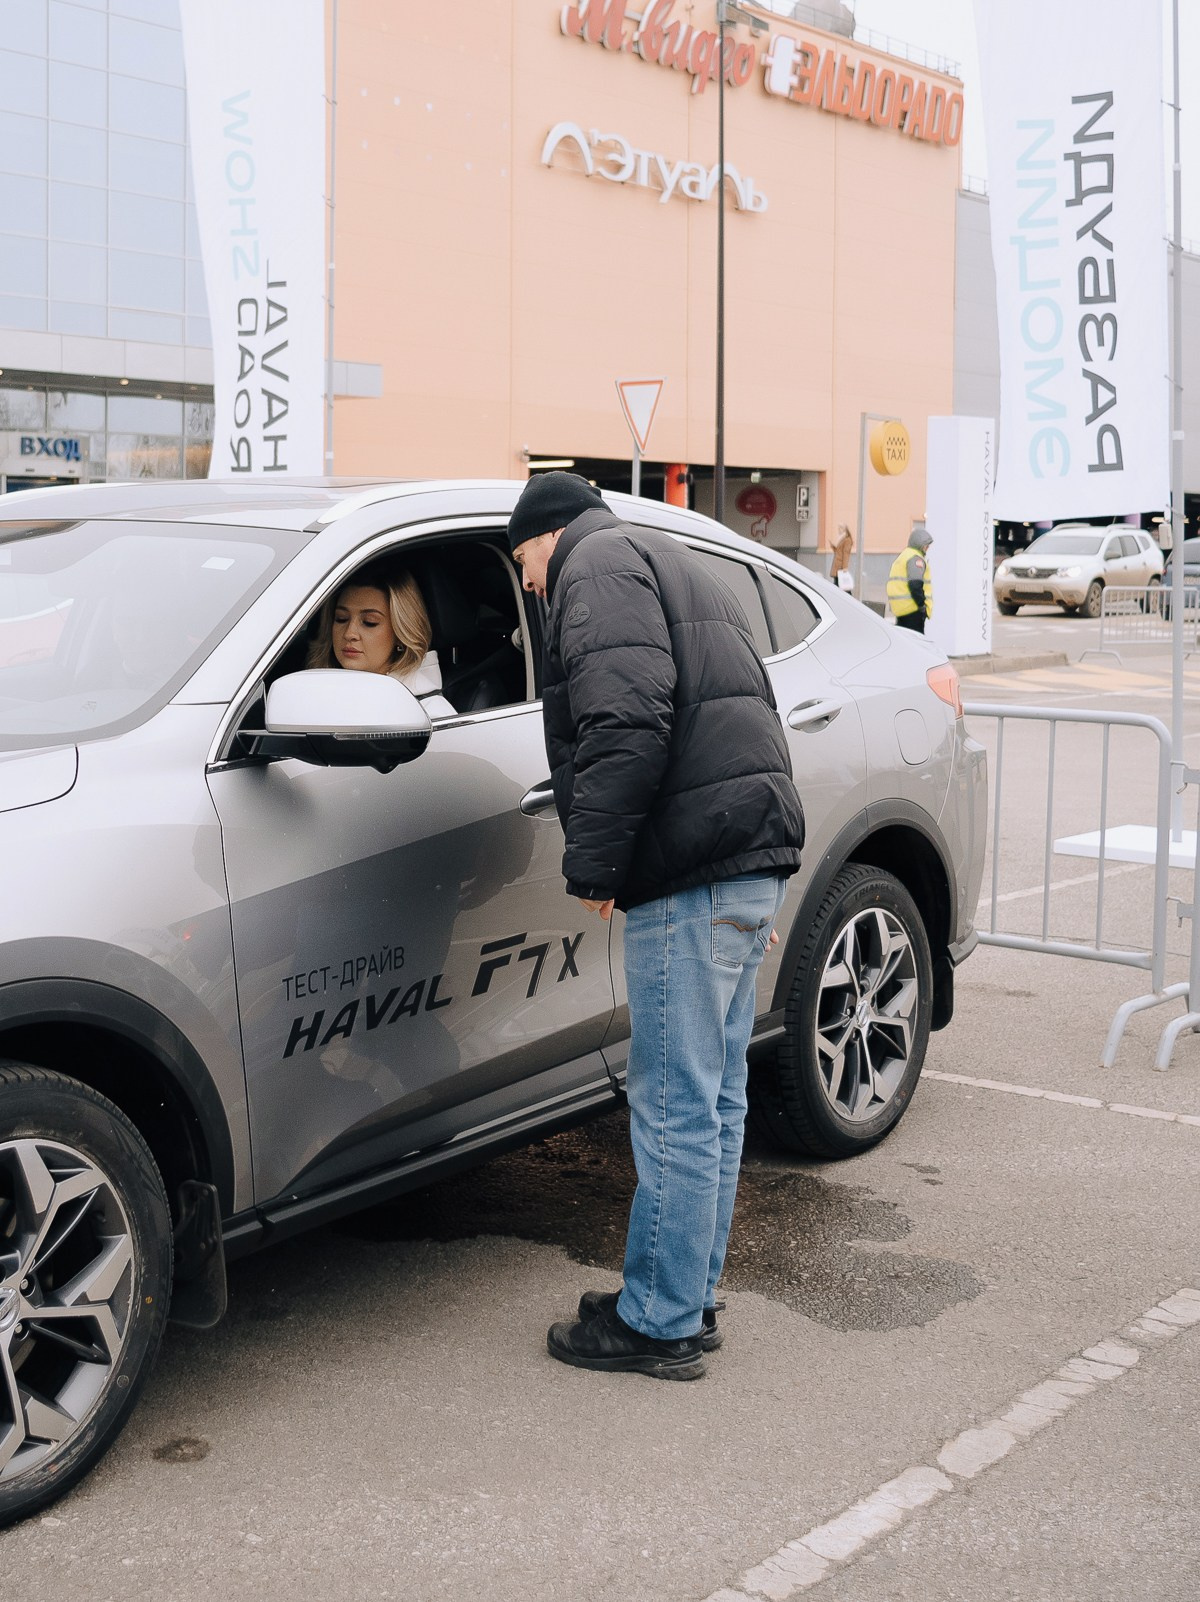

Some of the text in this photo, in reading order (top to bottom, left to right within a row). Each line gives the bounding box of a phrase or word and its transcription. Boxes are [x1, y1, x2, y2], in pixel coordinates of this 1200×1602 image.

[20, 436, 81, 461] ВХОД
[886, 448, 906, 461] TAXI
[282, 944, 405, 1001] ТЕСТ-ДРАЙВ
[282, 974, 454, 1059] HAVAL
